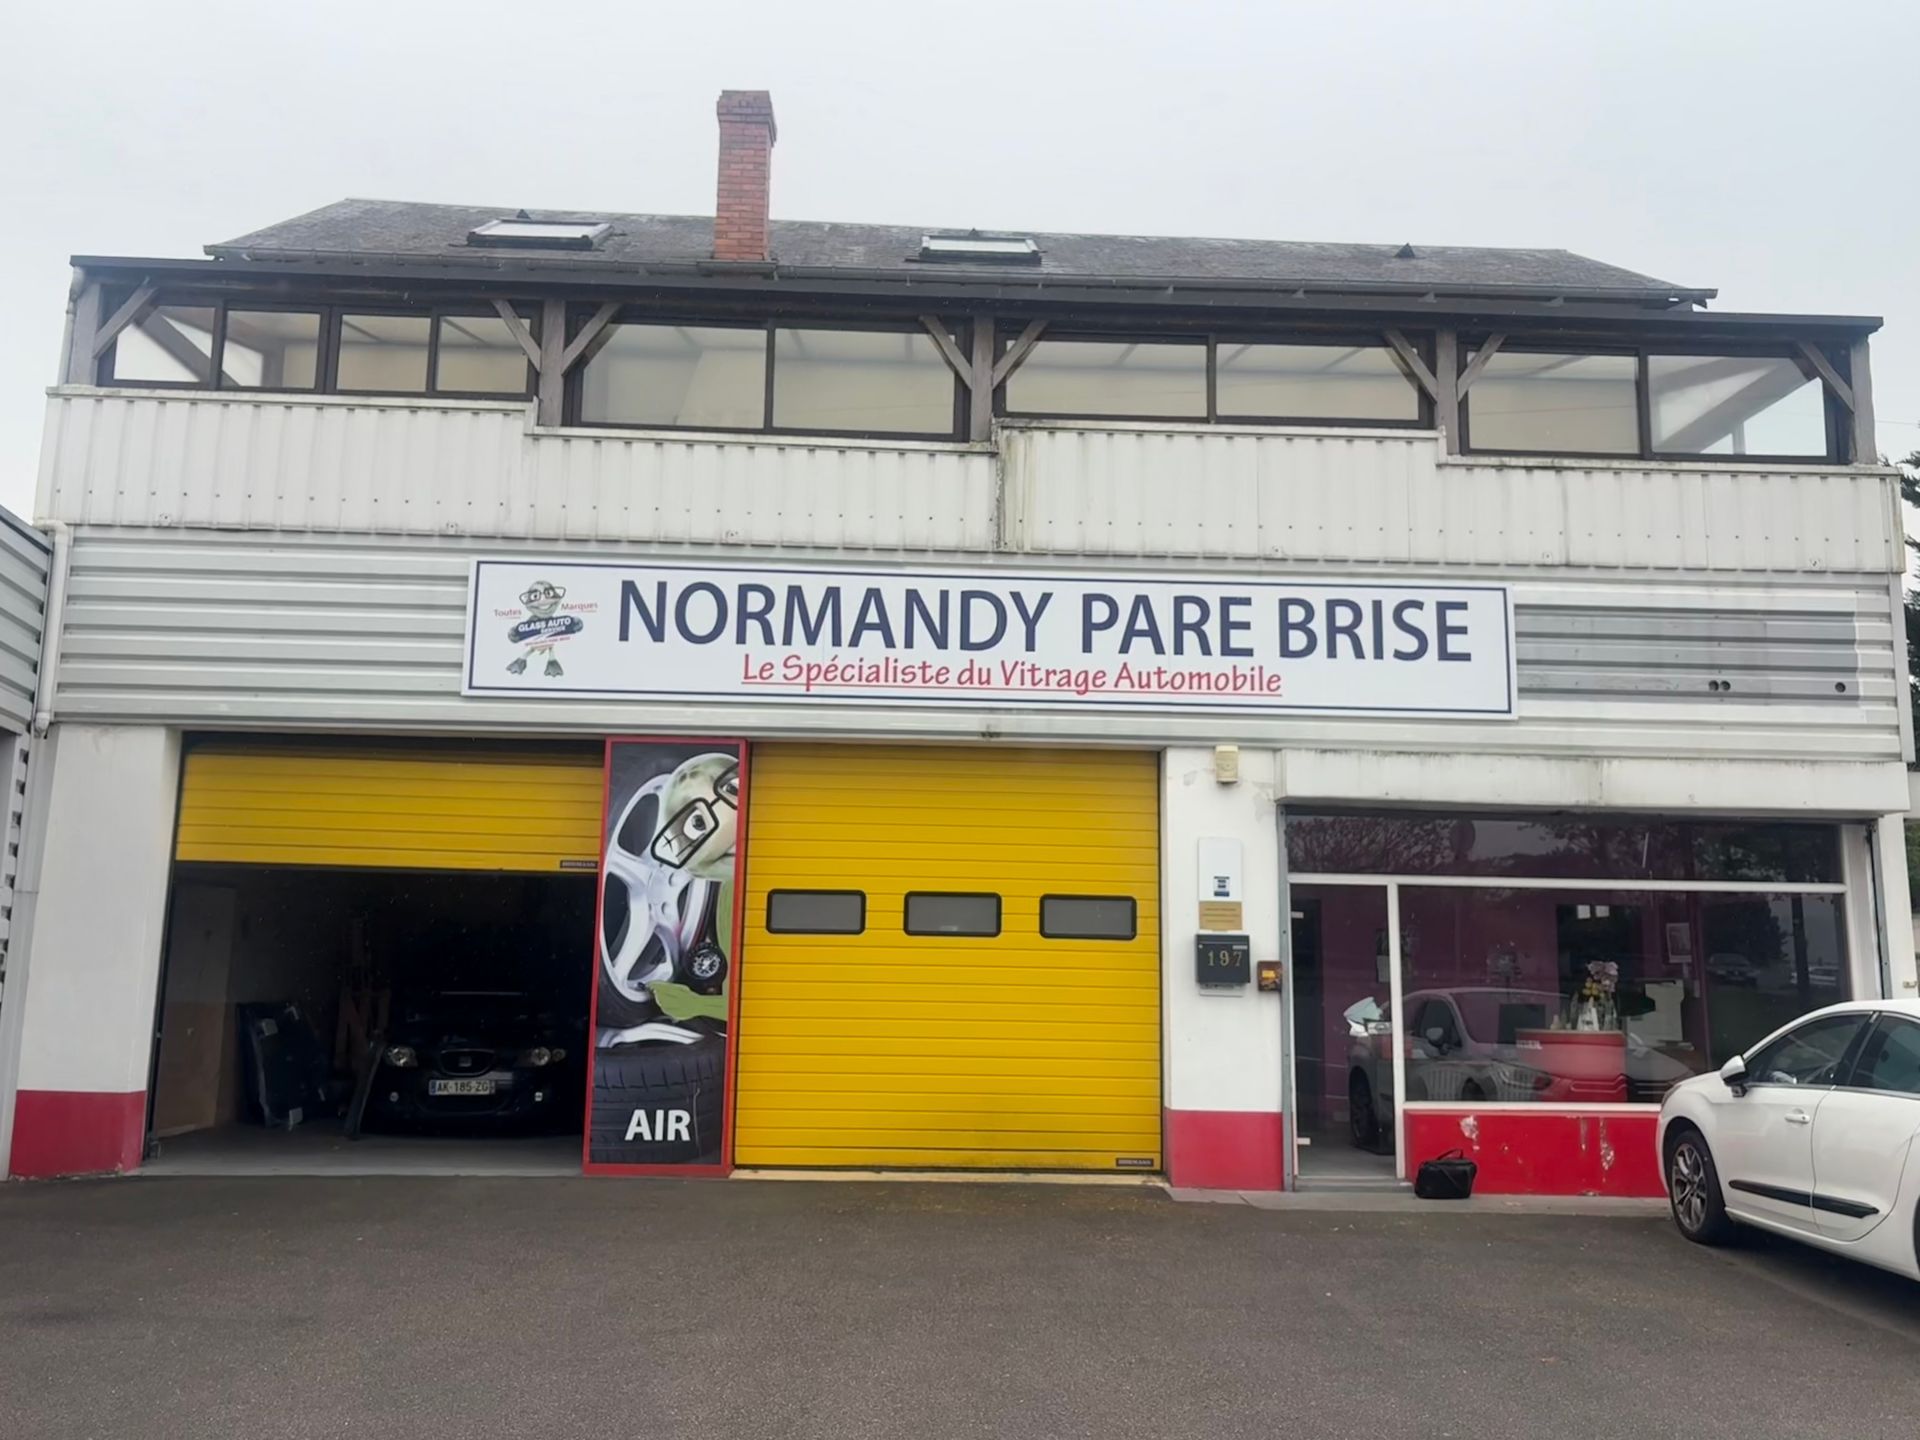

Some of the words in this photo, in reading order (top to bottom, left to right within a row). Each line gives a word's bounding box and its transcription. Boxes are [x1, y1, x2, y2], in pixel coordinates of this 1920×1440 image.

[494, 608, 522, 617] Toutes
[560, 602, 598, 612] Marques
[618, 579, 1054, 653] NORMANDY
[1081, 593, 1254, 658] PARE
[1278, 597, 1472, 662] BRISE
[518, 621, 546, 632] GLASS
[547, 617, 572, 627] AUTO
[743, 653, 773, 684] Le
[782, 655, 950, 692] Spécialiste
[957, 658, 992, 686] du
[1000, 660, 1107, 696] Vitrage
[1113, 662, 1282, 693] Automobile
[1207, 950, 1242, 967] 197
[625, 1109, 691, 1141] AIR
